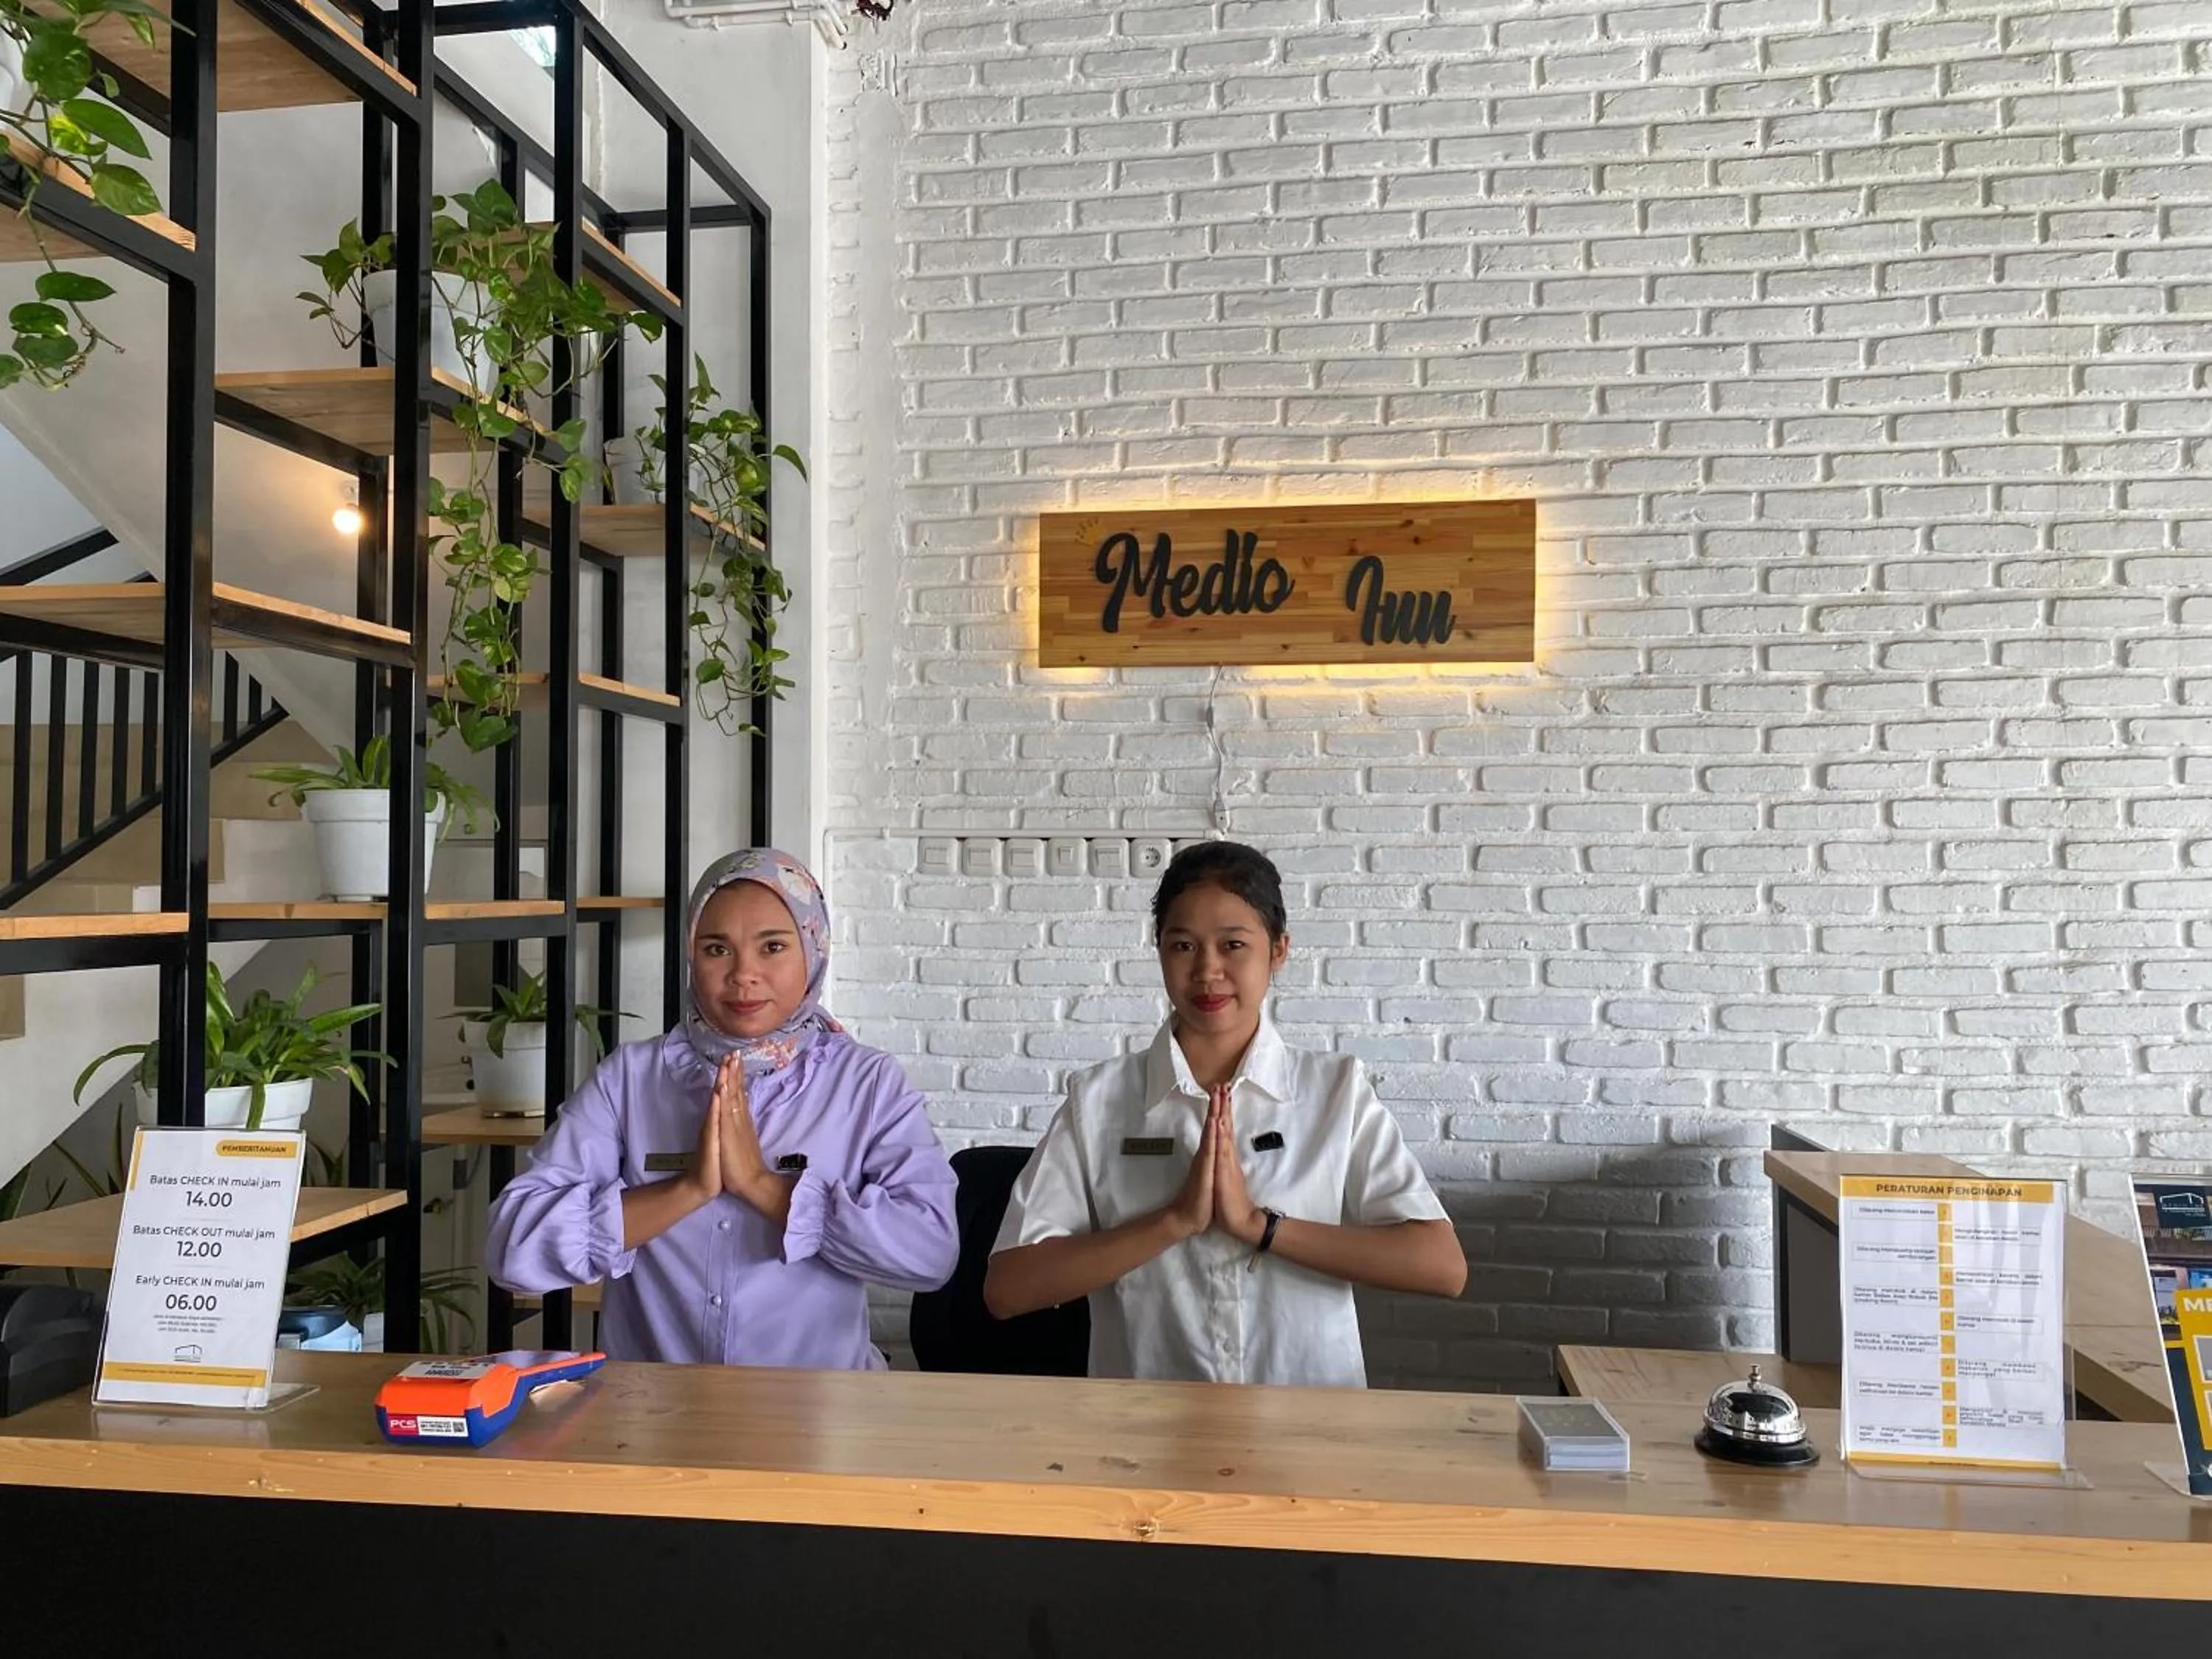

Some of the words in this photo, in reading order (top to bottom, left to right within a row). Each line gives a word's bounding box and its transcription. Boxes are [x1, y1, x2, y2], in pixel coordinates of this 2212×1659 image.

[1346, 555, 1457, 646] Inn
[222, 1144, 286, 1153] PEMBERITAHUAN
[150, 1175, 178, 1185] Batas
[180, 1176, 215, 1186] CHECK
[218, 1177, 229, 1186] IN
[231, 1177, 259, 1186] mulai
[260, 1178, 281, 1189] jam
[1876, 1183, 1944, 1195] PERATURAN
[1947, 1186, 2023, 1197] PENGINAPAN
[186, 1191, 232, 1207] 14.00
[133, 1225, 161, 1235] Batas
[163, 1226, 198, 1237] CHECK
[201, 1227, 223, 1237] OUT
[225, 1228, 254, 1238] mulai
[255, 1229, 275, 1240] jam
[176, 1241, 222, 1258] 12.00
[135, 1275, 161, 1287] Early
[163, 1276, 198, 1287] CHECK
[201, 1277, 212, 1287] IN
[215, 1278, 243, 1288] mulai
[245, 1279, 265, 1290] jam
[166, 1294, 217, 1310] 06.00
[390, 1419, 417, 1428] PCS
